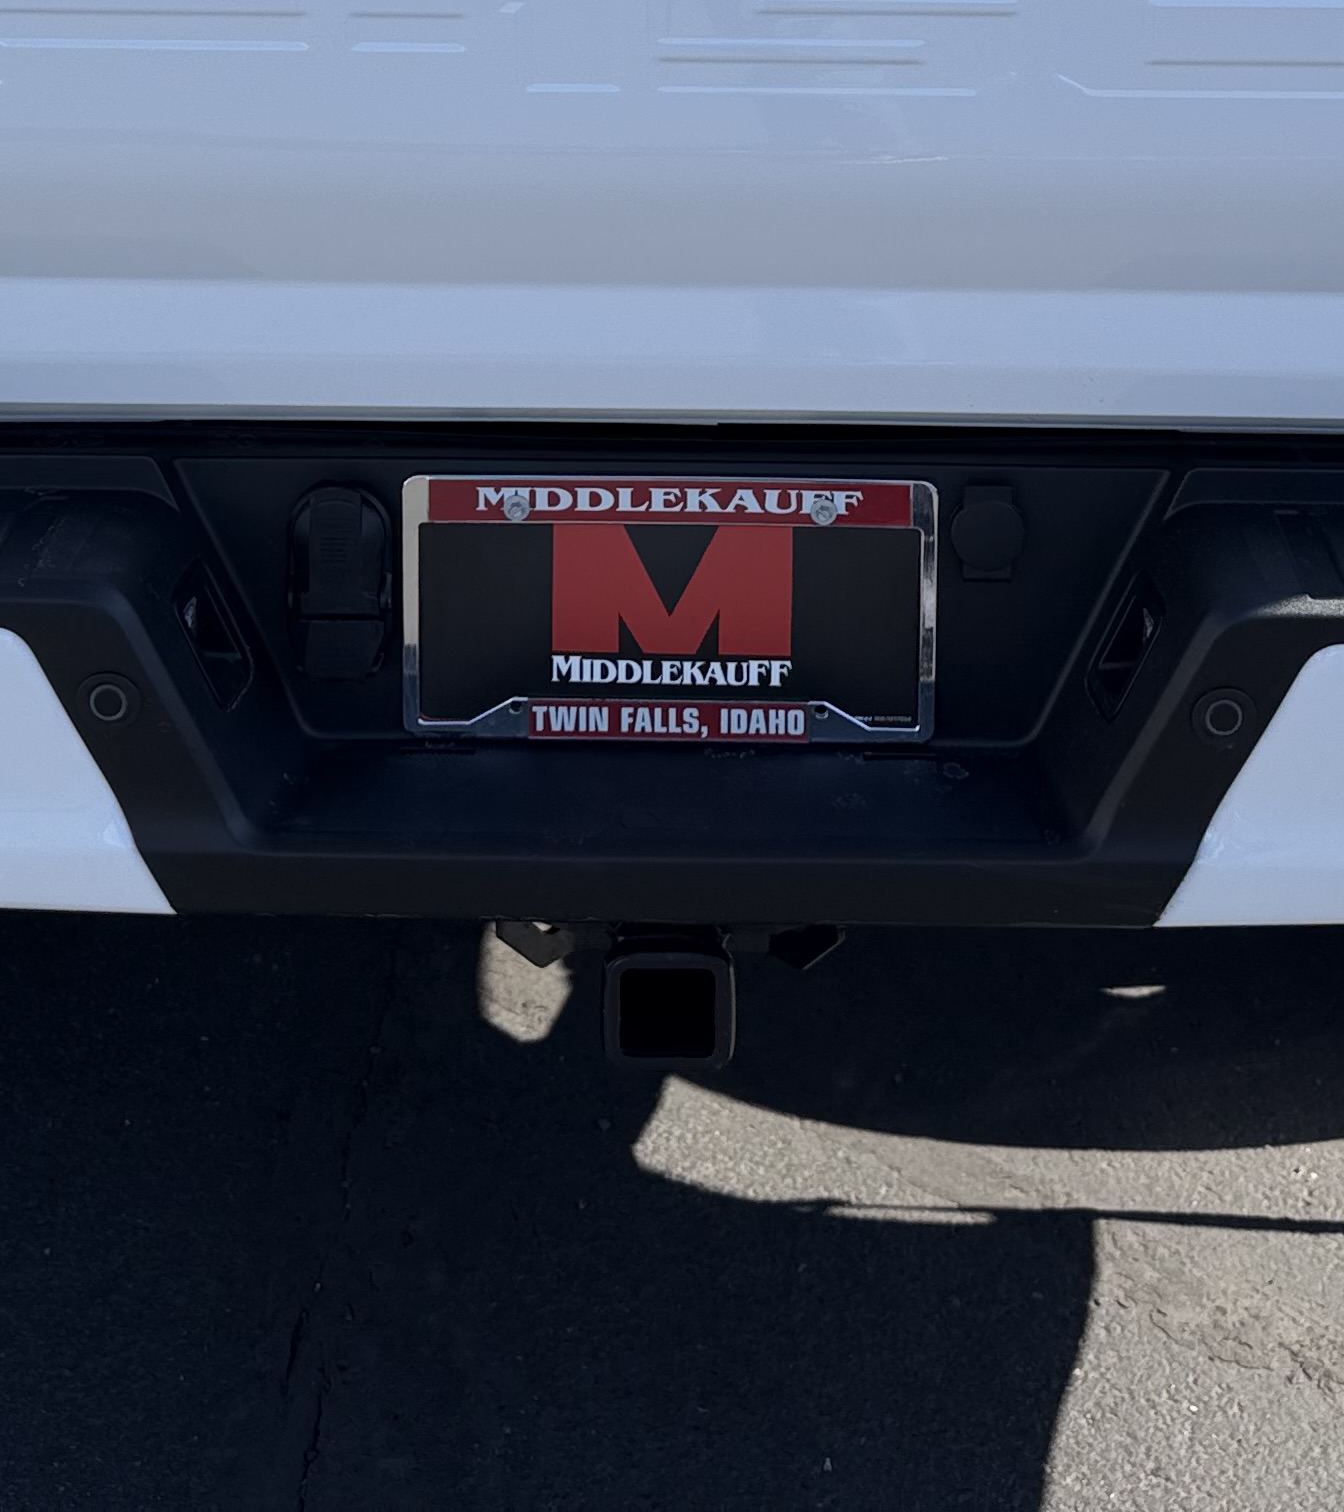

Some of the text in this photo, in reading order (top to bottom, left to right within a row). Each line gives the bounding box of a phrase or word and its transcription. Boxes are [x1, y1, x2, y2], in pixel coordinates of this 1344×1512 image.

[475, 486, 864, 517] MIDDLEKAUFF
[552, 524, 794, 656] M
[550, 654, 793, 687] MIDDLEKAUFF
[532, 704, 807, 739] TWIN FALLS, IDAHO
